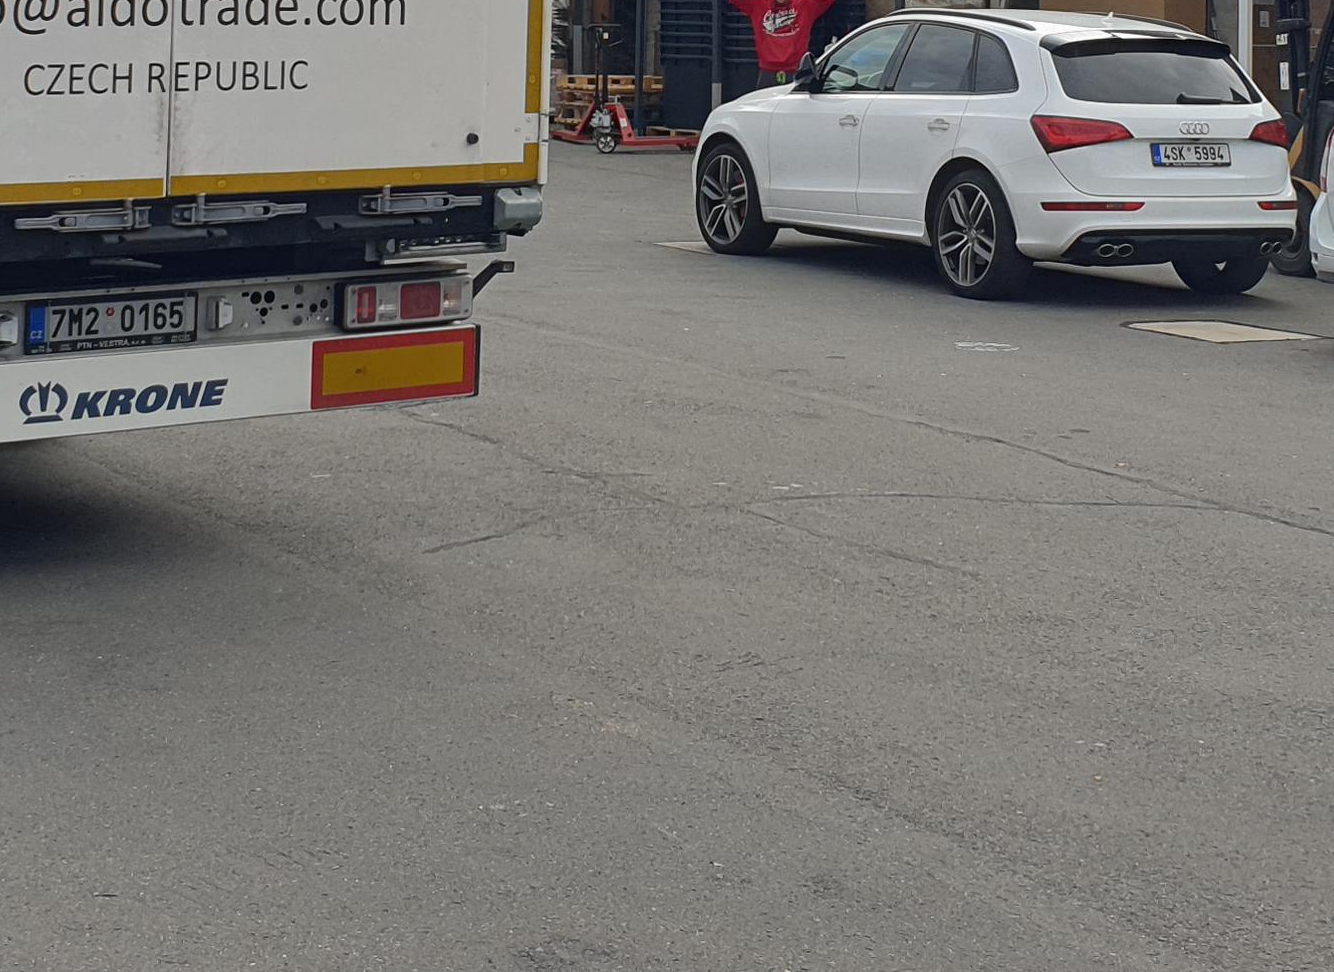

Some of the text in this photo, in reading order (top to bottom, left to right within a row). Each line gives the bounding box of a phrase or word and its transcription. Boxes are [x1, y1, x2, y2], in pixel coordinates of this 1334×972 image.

[23, 59, 309, 97] CZECH REPUBLIC
[1164, 146, 1186, 161] 4SK
[1194, 146, 1224, 161] 5994
[29, 330, 43, 339] CZ
[51, 301, 184, 339] 7M2 0165
[71, 378, 229, 420] KRONE
